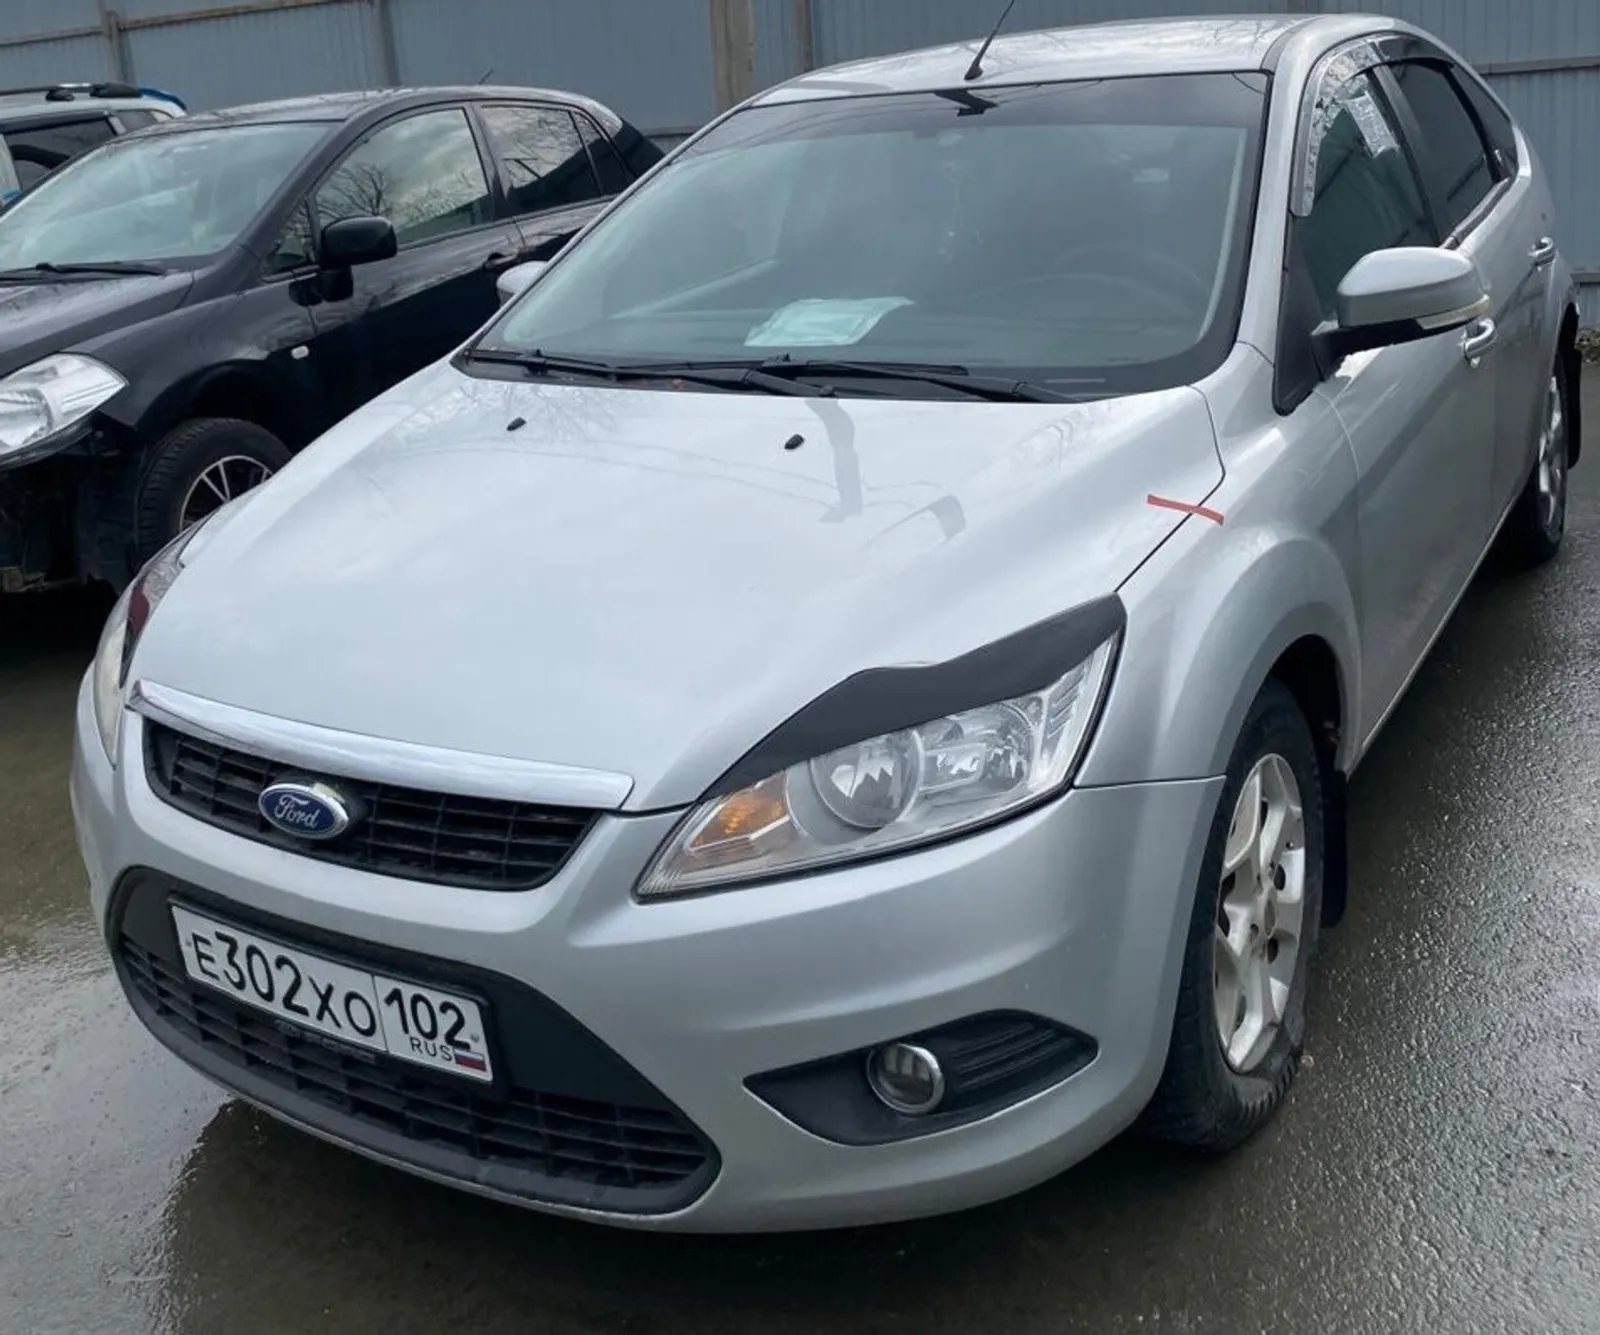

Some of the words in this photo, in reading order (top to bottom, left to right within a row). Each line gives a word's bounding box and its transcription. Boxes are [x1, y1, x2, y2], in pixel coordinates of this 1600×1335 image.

[274, 794, 320, 829] Ford
[384, 987, 471, 1050] 102
[410, 1035, 453, 1062] RUS
